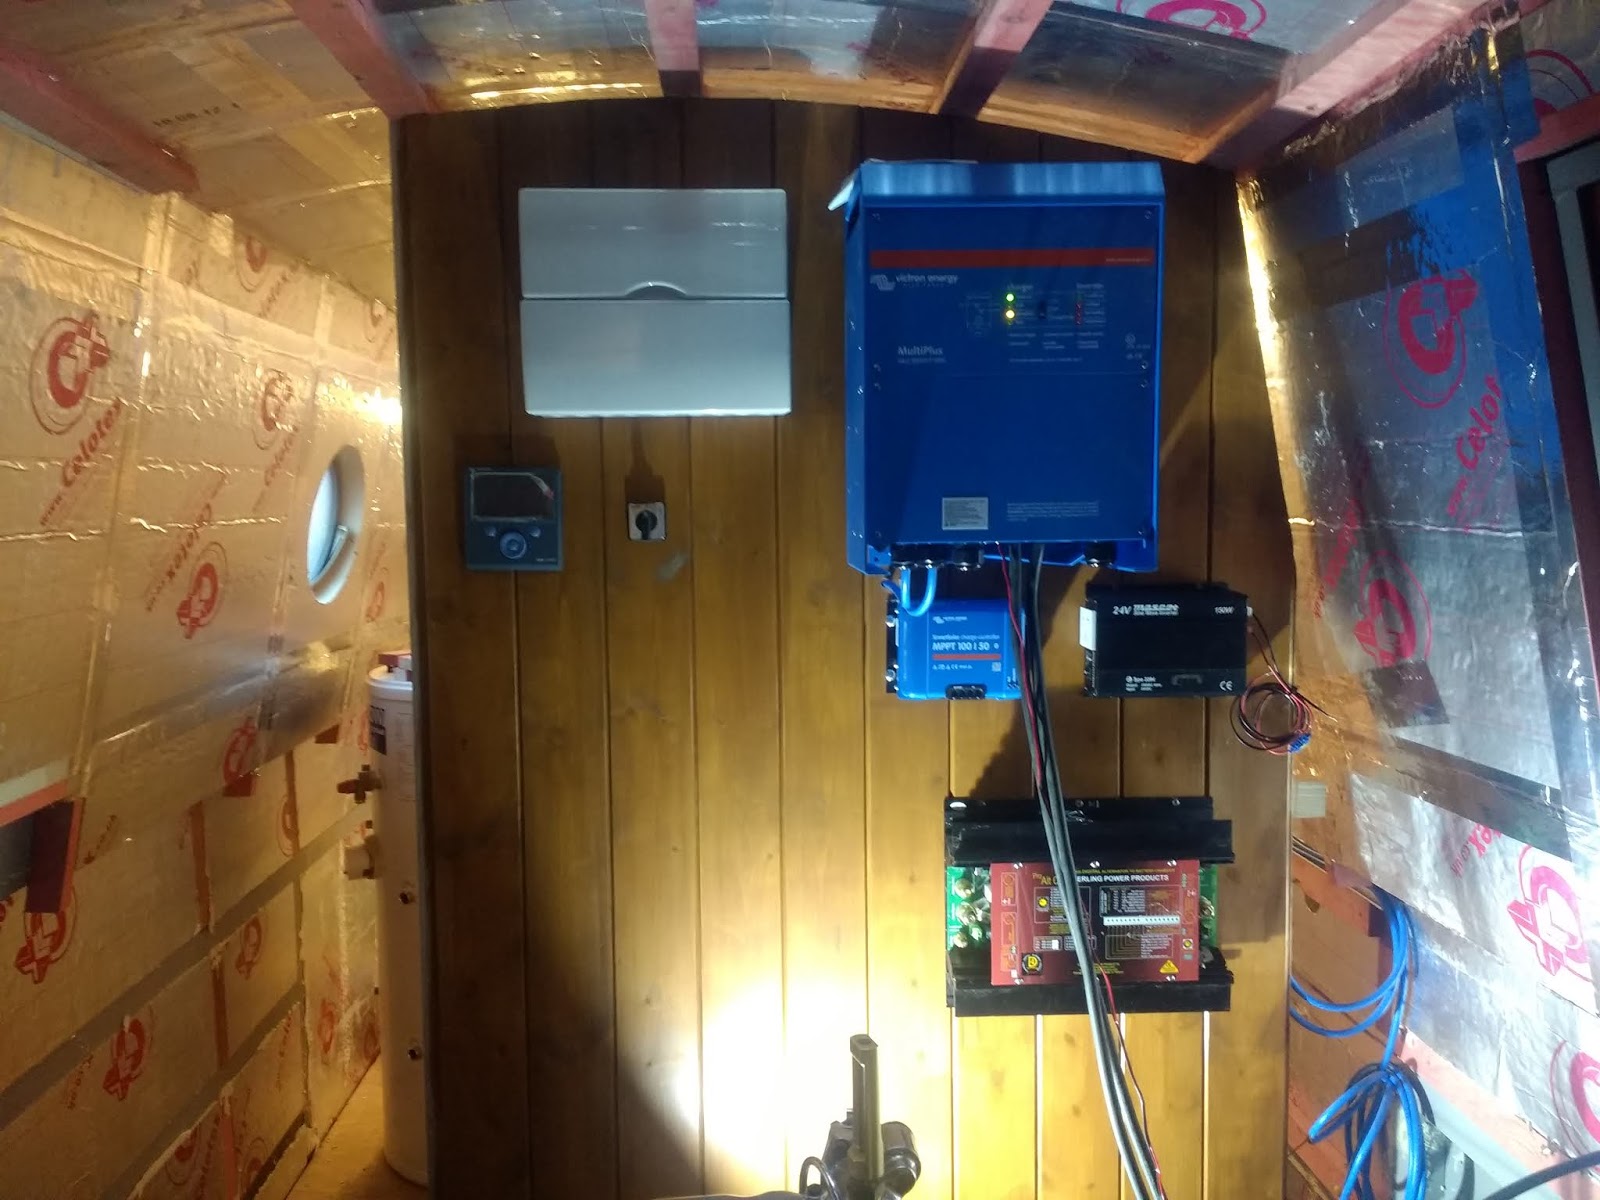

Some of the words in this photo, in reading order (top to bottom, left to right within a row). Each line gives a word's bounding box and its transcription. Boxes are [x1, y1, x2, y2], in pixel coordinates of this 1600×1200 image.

[898, 346, 943, 356] MultiPlus
[1112, 605, 1132, 616] 24V
[932, 642, 956, 651] MPPT
[957, 641, 973, 651] 100
[978, 641, 991, 651] 50
[1131, 874, 1169, 882] PRODUCTS
